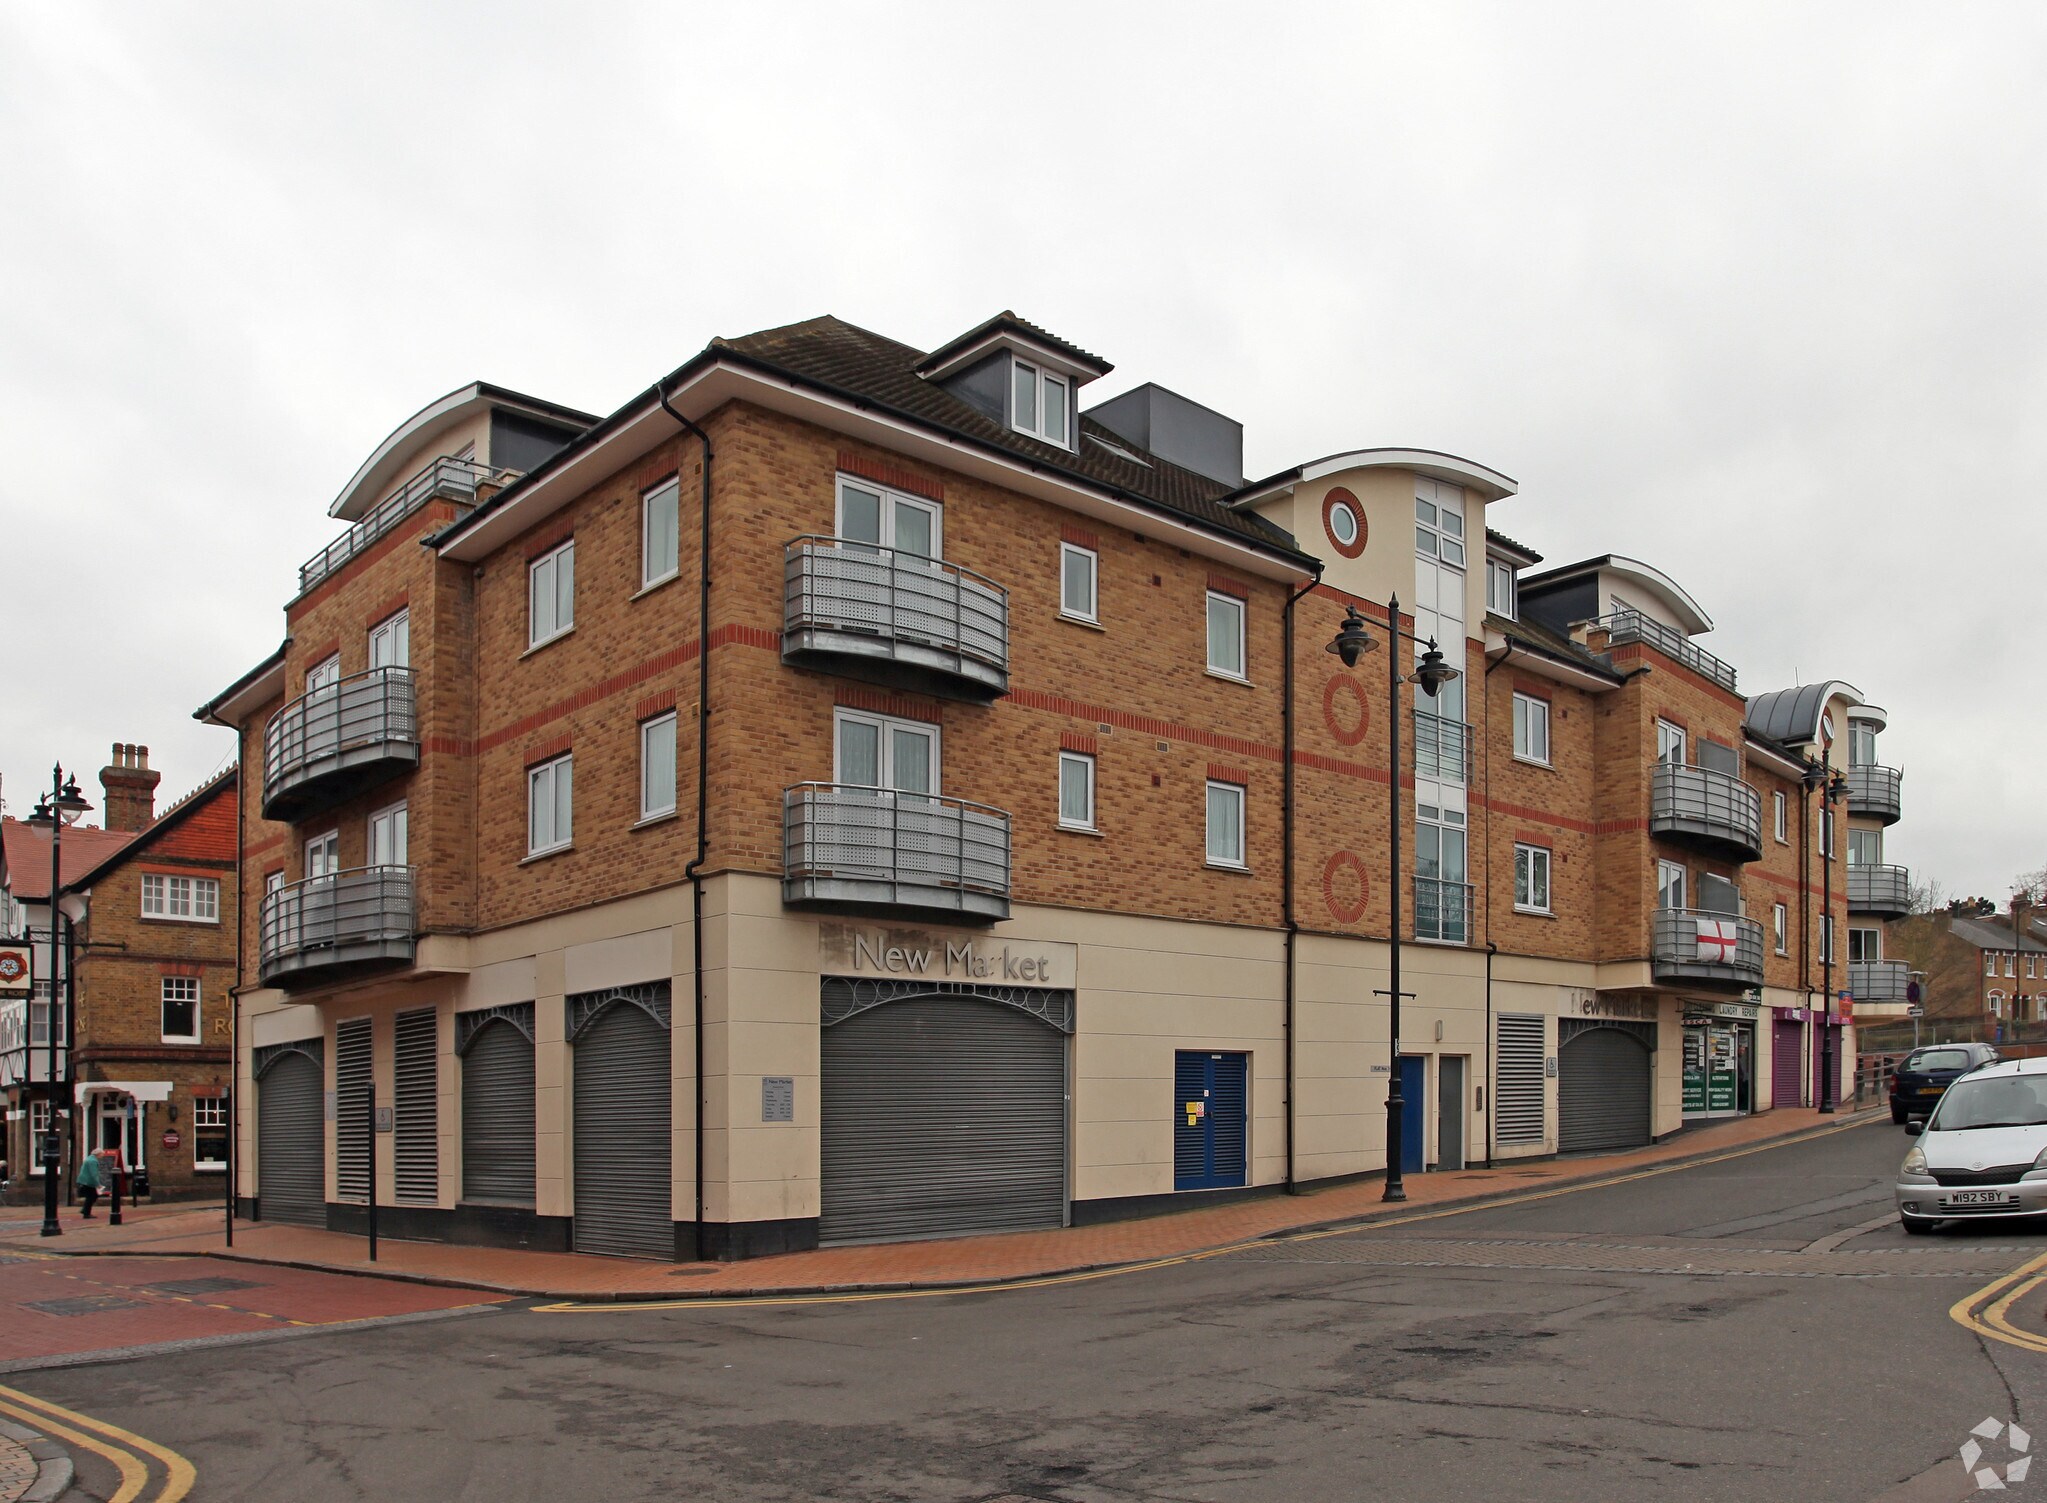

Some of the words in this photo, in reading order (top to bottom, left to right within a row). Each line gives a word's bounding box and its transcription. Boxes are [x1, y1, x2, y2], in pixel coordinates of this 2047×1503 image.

[854, 933, 932, 973] New
[1720, 1004, 1738, 1016] LAUNDRY
[1742, 1006, 1758, 1017] REPAIRS
[1952, 1193, 1977, 1203] W192
[1980, 1192, 2002, 1202] SBY
